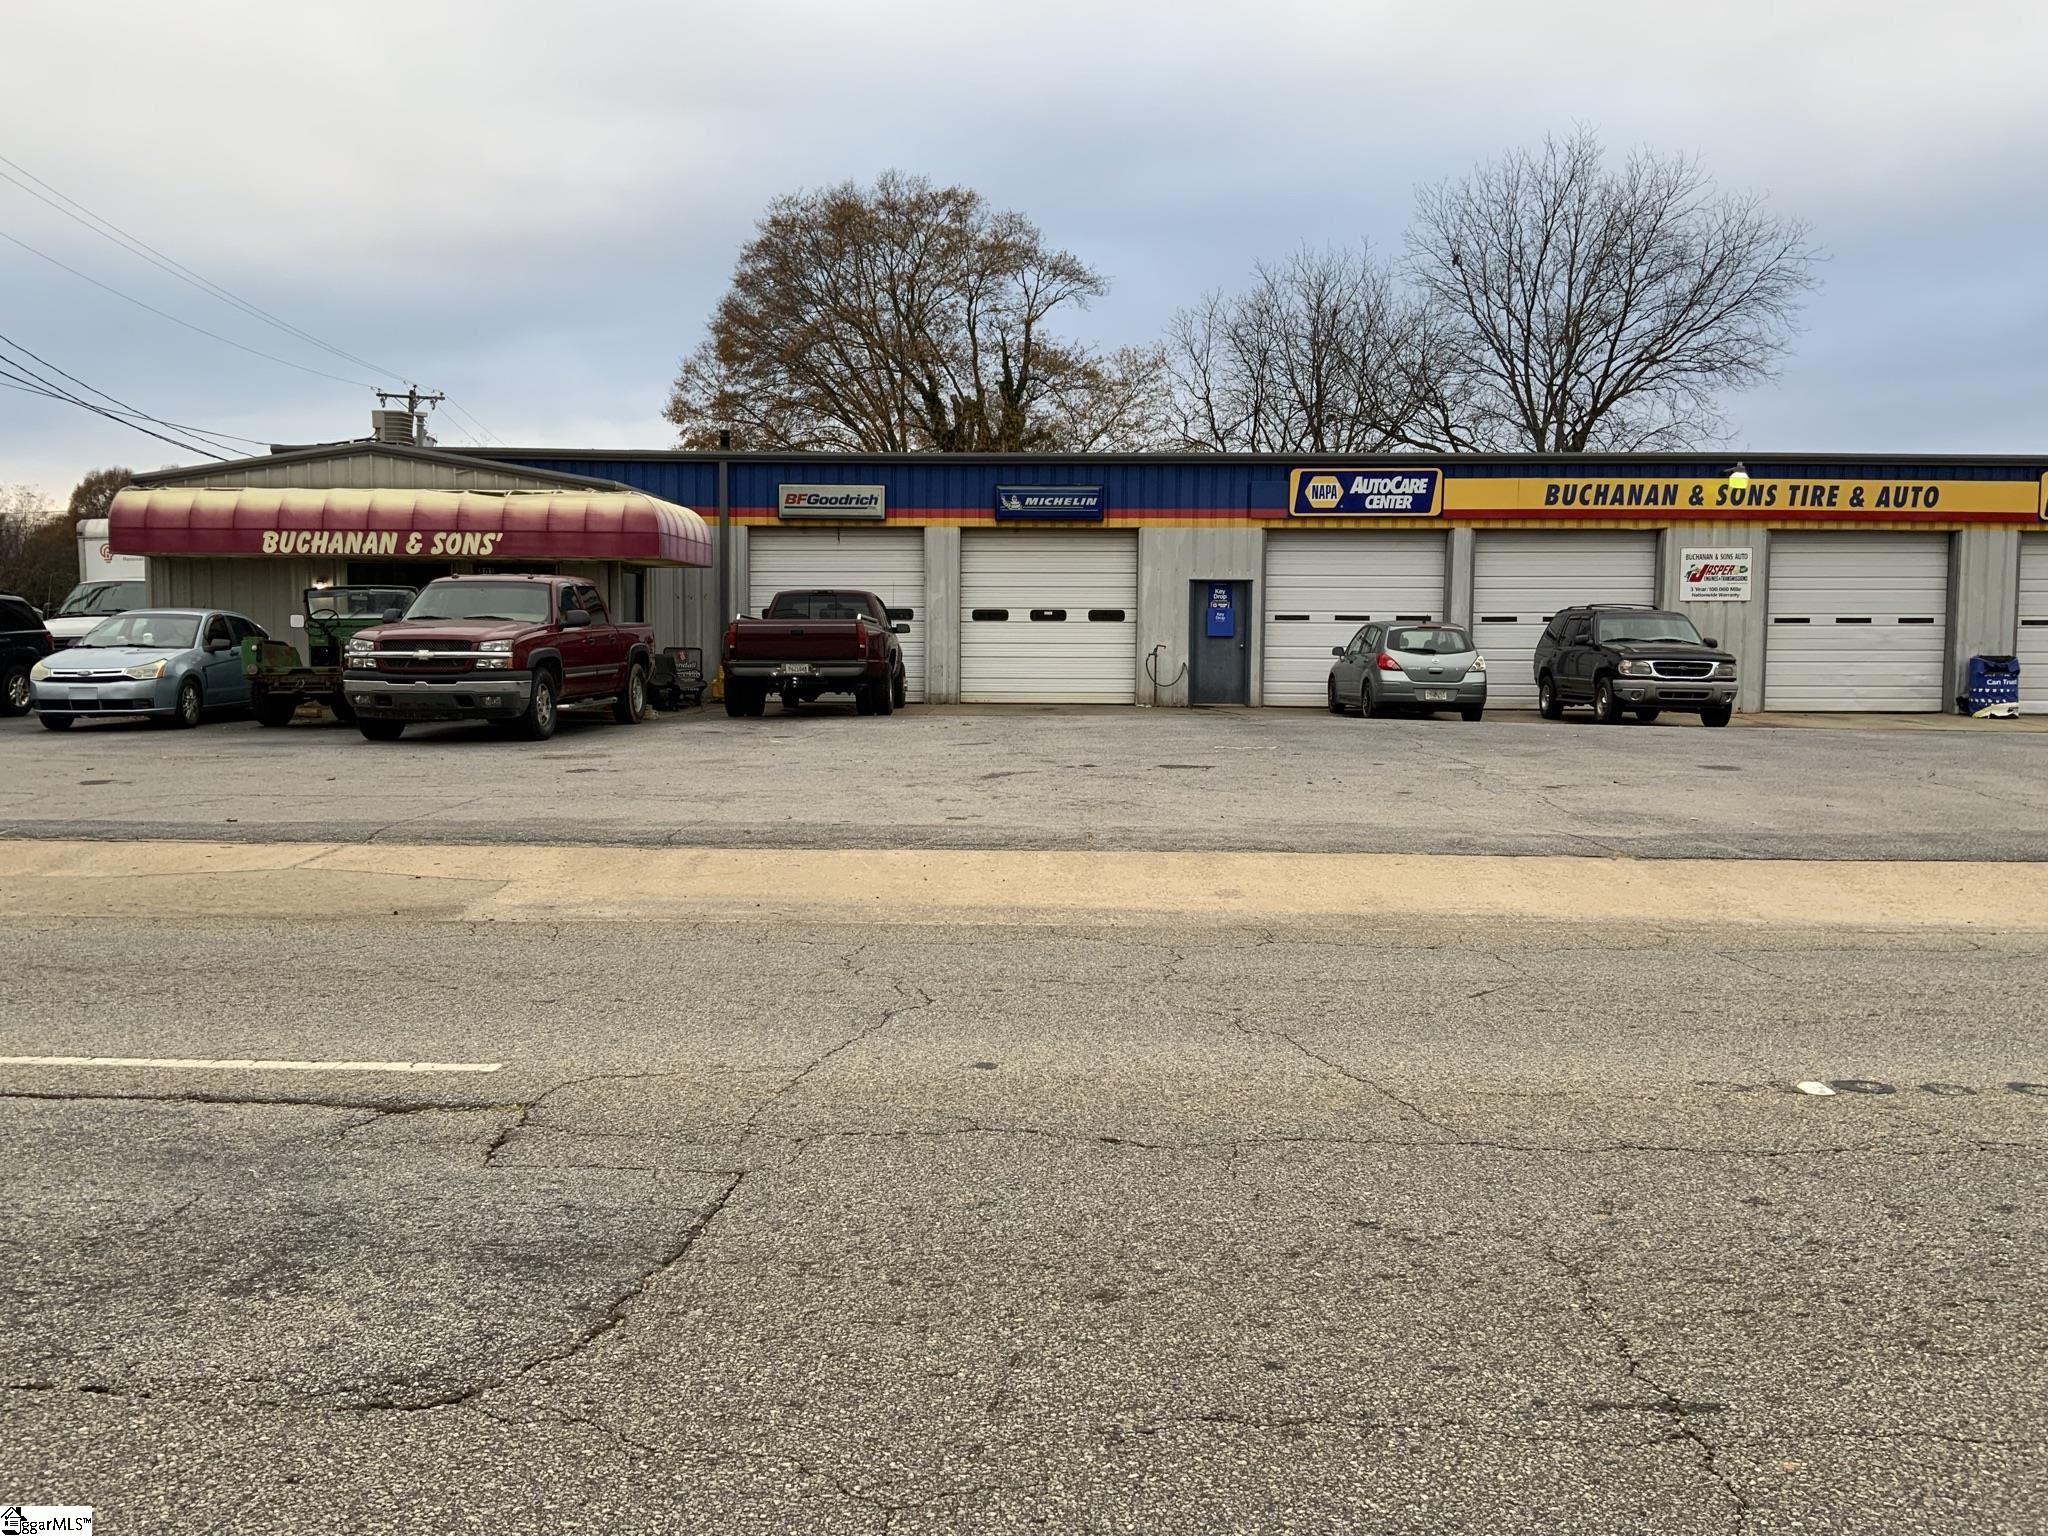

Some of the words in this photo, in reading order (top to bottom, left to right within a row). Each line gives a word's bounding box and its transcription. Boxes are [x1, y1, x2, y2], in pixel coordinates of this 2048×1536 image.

[784, 493, 879, 506] BFGoodrich
[1311, 484, 1338, 500] NAPA
[1544, 484, 1679, 506] BUCHANAN
[1688, 485, 1704, 506] &
[1715, 484, 1778, 507] SONS
[1788, 484, 1840, 507] TIRE
[1849, 486, 1864, 508] &
[1874, 486, 1940, 508] AUTO
[1024, 497, 1098, 506] MICHELIN
[1364, 495, 1413, 509] CENTER
[262, 531, 398, 554] BUCHANAN
[405, 532, 423, 554] &
[1689, 564, 1735, 582] JASPER
